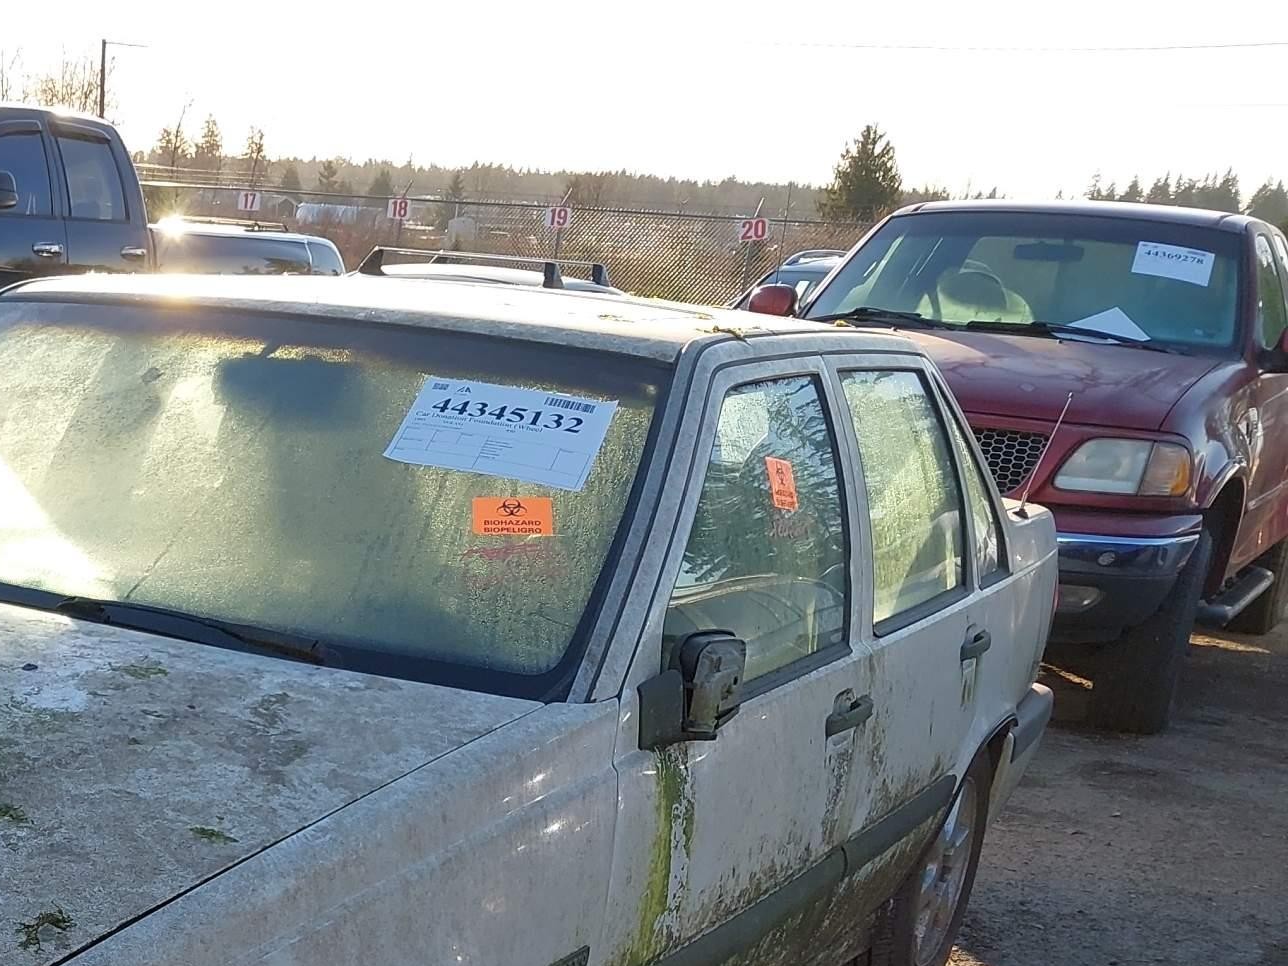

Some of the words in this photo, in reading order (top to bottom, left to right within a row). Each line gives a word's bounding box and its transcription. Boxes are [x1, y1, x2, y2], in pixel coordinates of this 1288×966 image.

[243, 192, 257, 210] 17
[391, 200, 409, 218] 18
[549, 207, 569, 227] 19
[740, 219, 768, 242] 20
[1144, 249, 1206, 265] 44369278
[431, 397, 584, 434] 44345132
